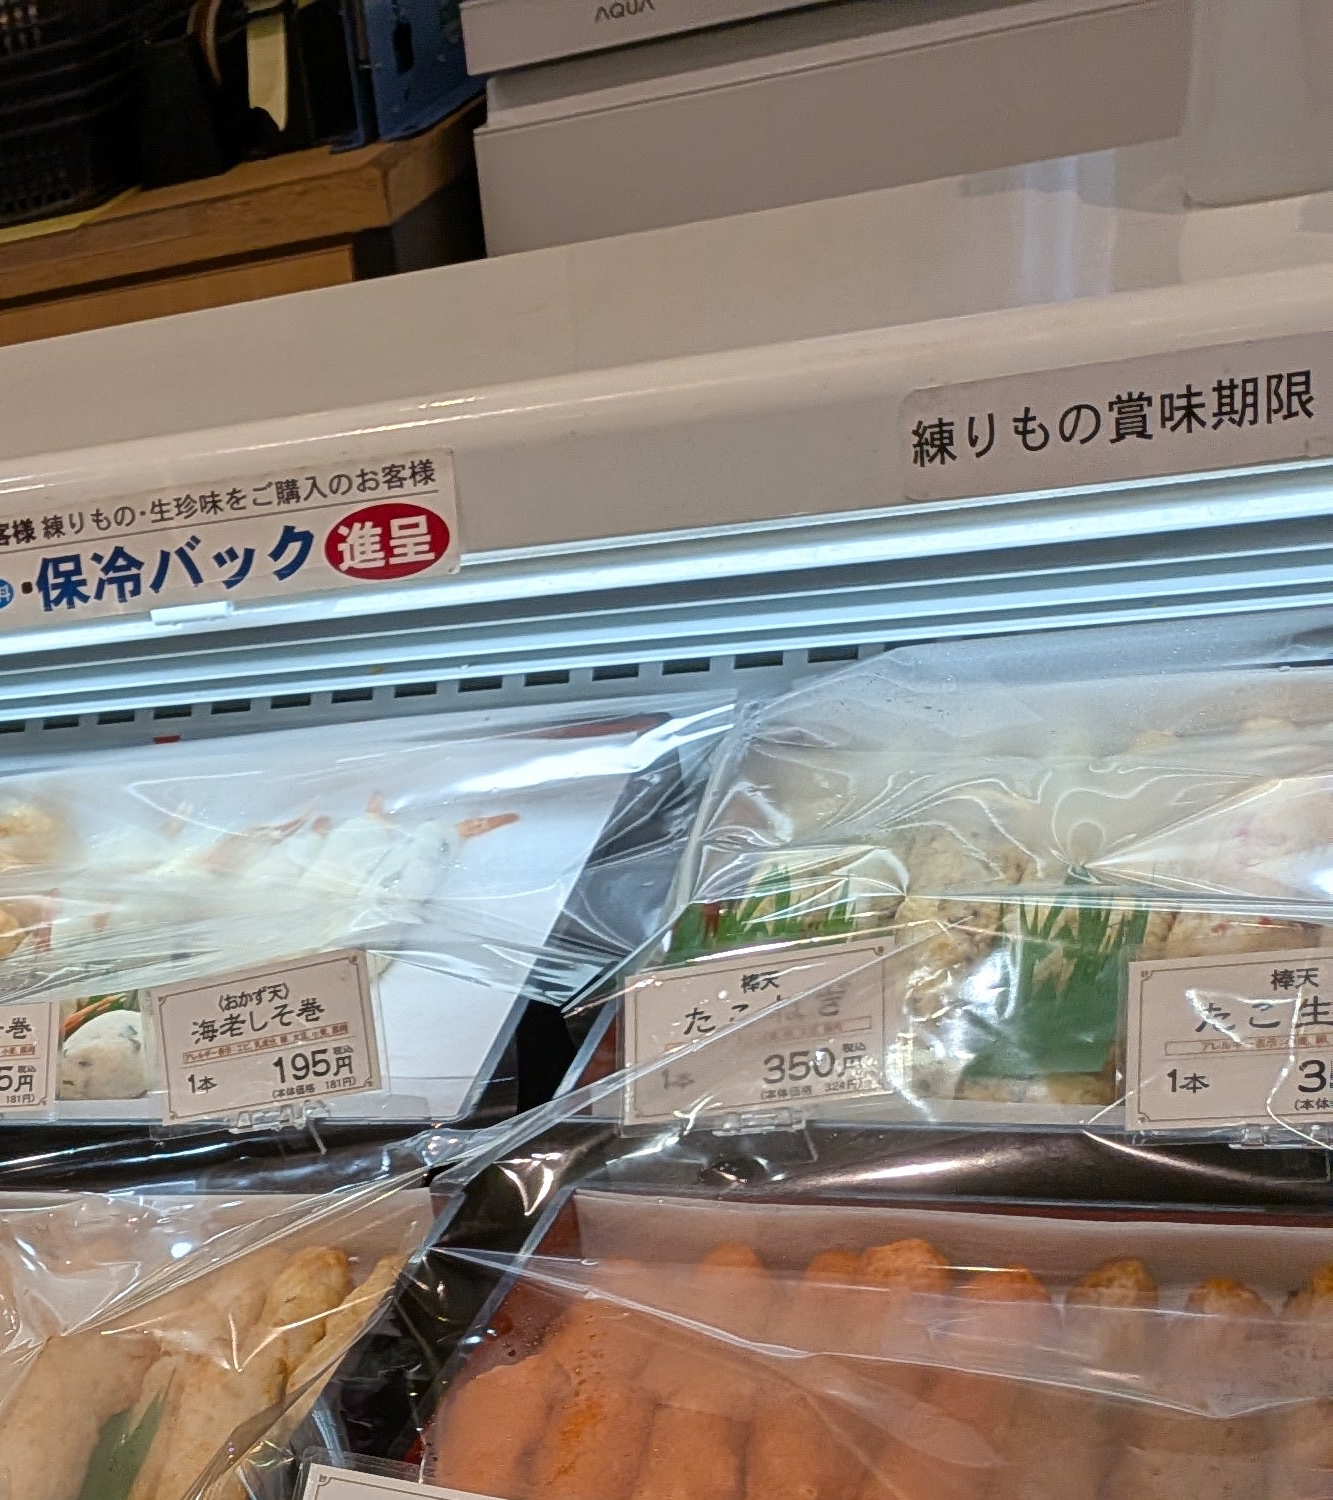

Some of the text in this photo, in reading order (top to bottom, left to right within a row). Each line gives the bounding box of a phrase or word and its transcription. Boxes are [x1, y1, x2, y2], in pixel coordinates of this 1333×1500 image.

[911, 369, 1315, 468] 練りもの賞味期限
[335, 512, 438, 574] 進呈
[218, 982, 290, 1012] (おかず天)
[1271, 967, 1319, 991] 棒天
[191, 998, 326, 1044] 海老しそ巻
[187, 1073, 218, 1095] 1本
[271, 1048, 354, 1084] 195円
[1166, 1068, 1210, 1094] 1本
